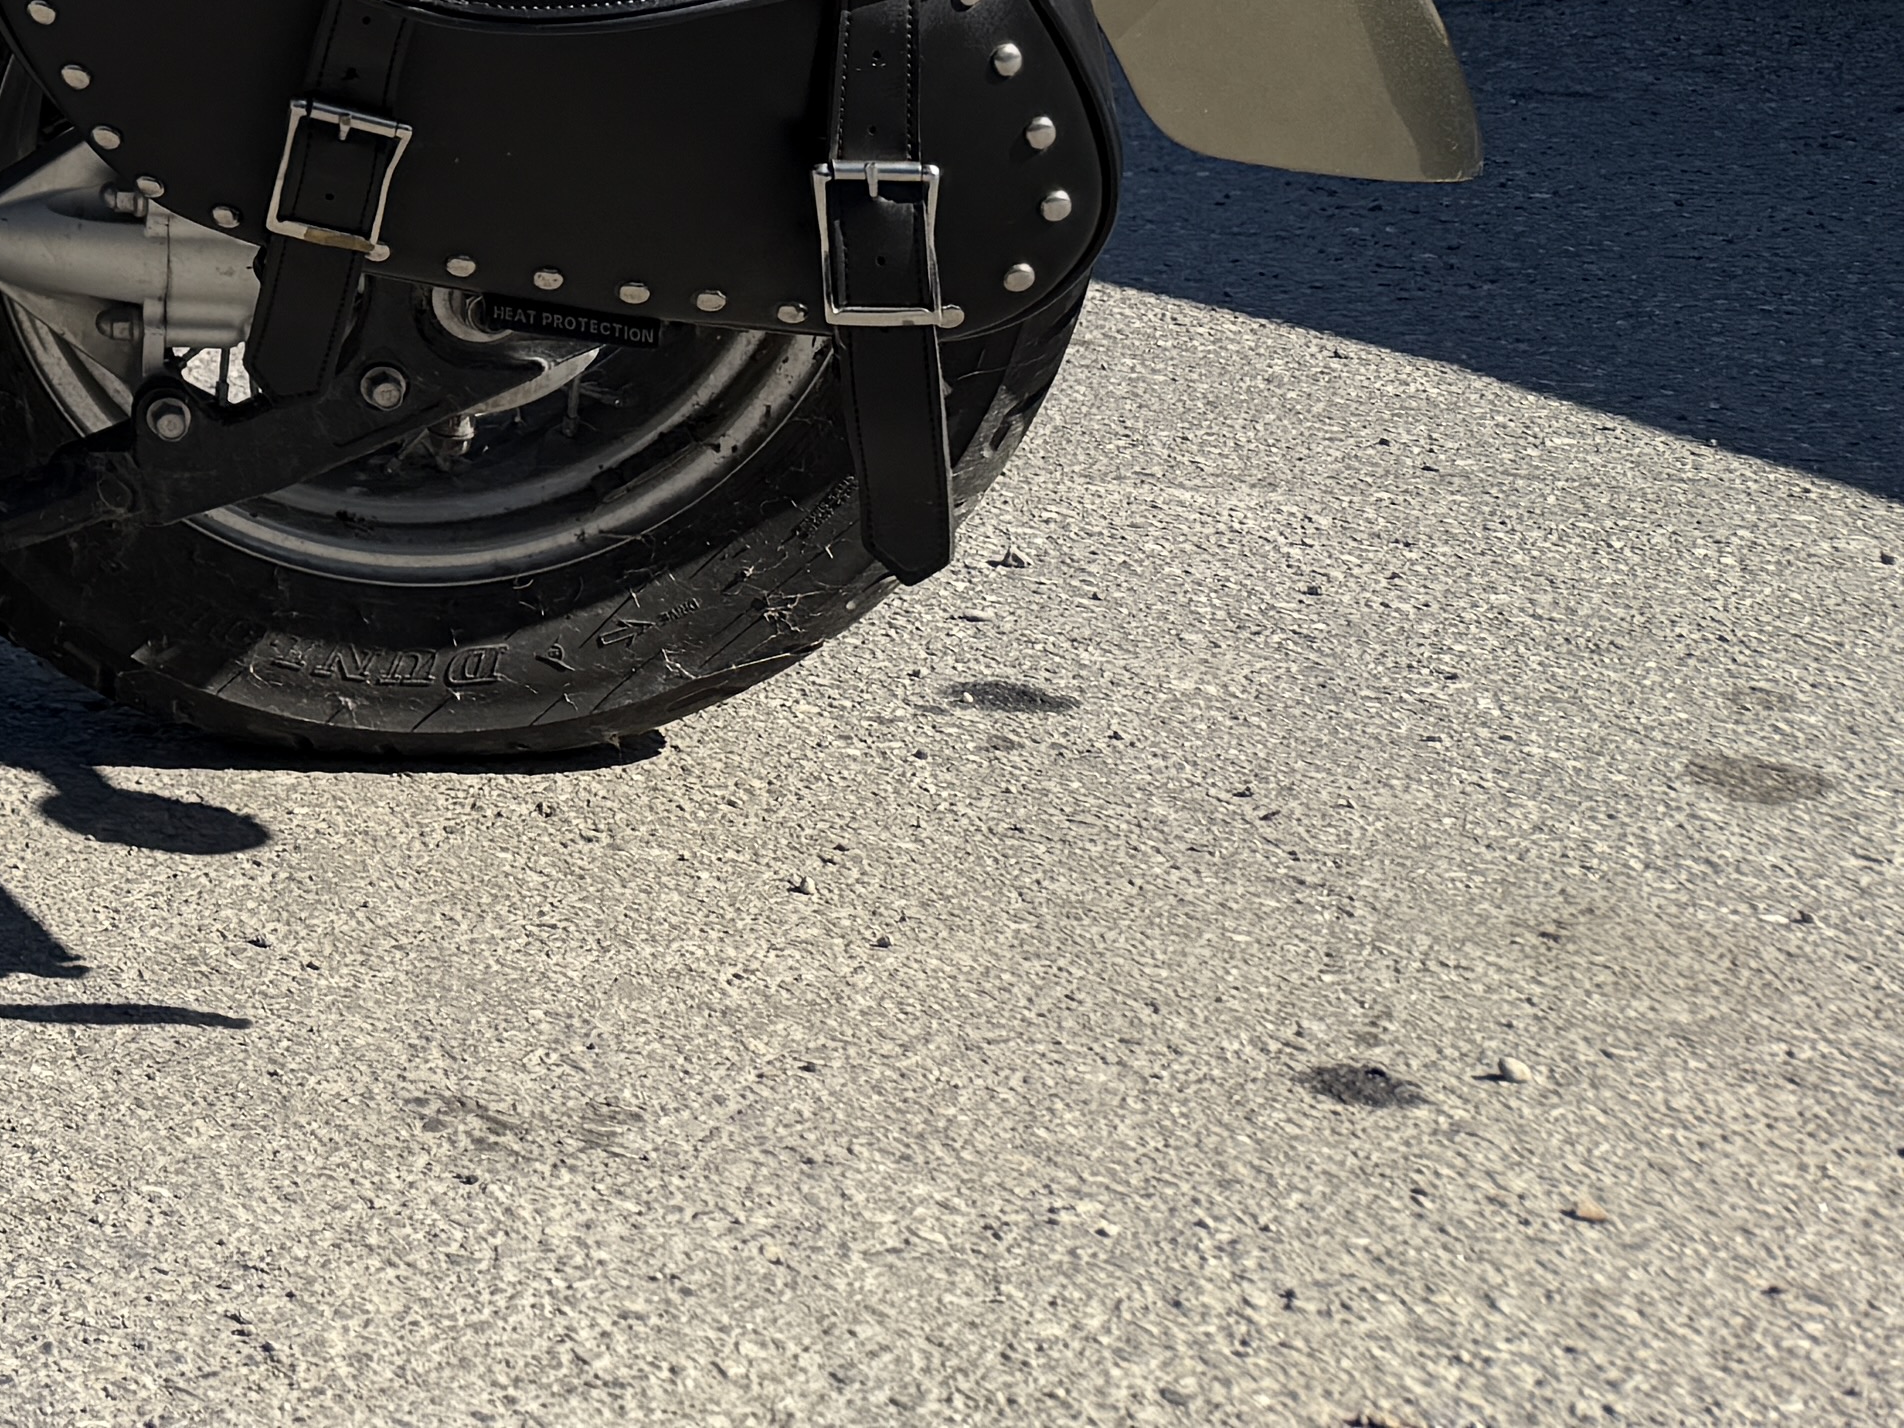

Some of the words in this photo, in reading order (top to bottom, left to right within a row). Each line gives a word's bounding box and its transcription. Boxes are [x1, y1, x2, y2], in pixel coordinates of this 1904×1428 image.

[494, 305, 544, 326] HEAT
[542, 312, 656, 344] PROTECTION
[657, 597, 701, 624] DRIVE
